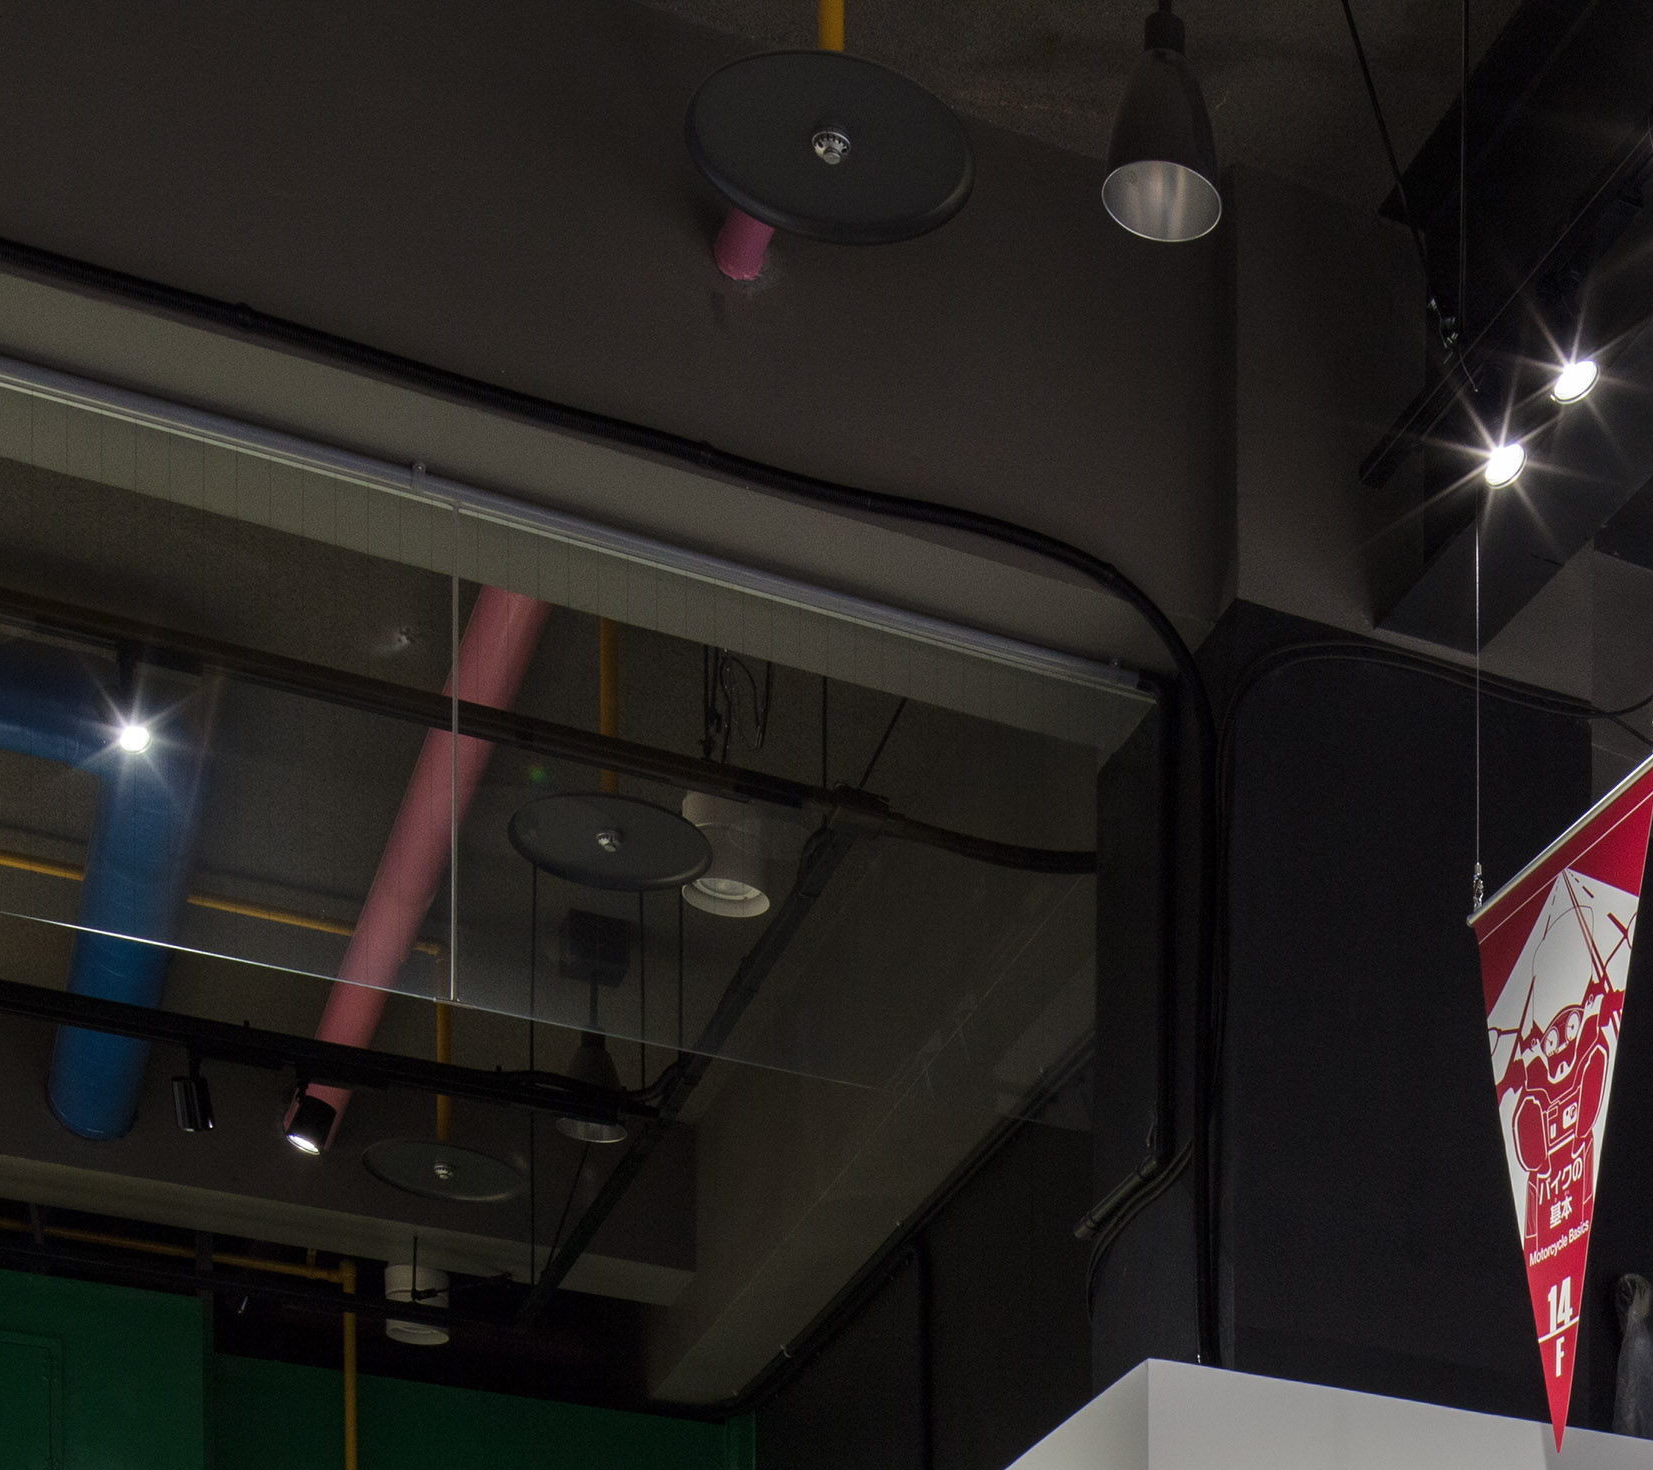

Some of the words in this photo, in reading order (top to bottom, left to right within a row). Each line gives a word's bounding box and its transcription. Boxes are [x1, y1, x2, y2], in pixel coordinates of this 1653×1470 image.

[1538, 1156, 1583, 1206] バイクの
[1549, 1195, 1573, 1229] 基本
[1529, 1234, 1568, 1267] Motorcycle
[1568, 1220, 1590, 1244] Basics
[1547, 1275, 1573, 1334] 14
[1555, 1335, 1565, 1378] F
